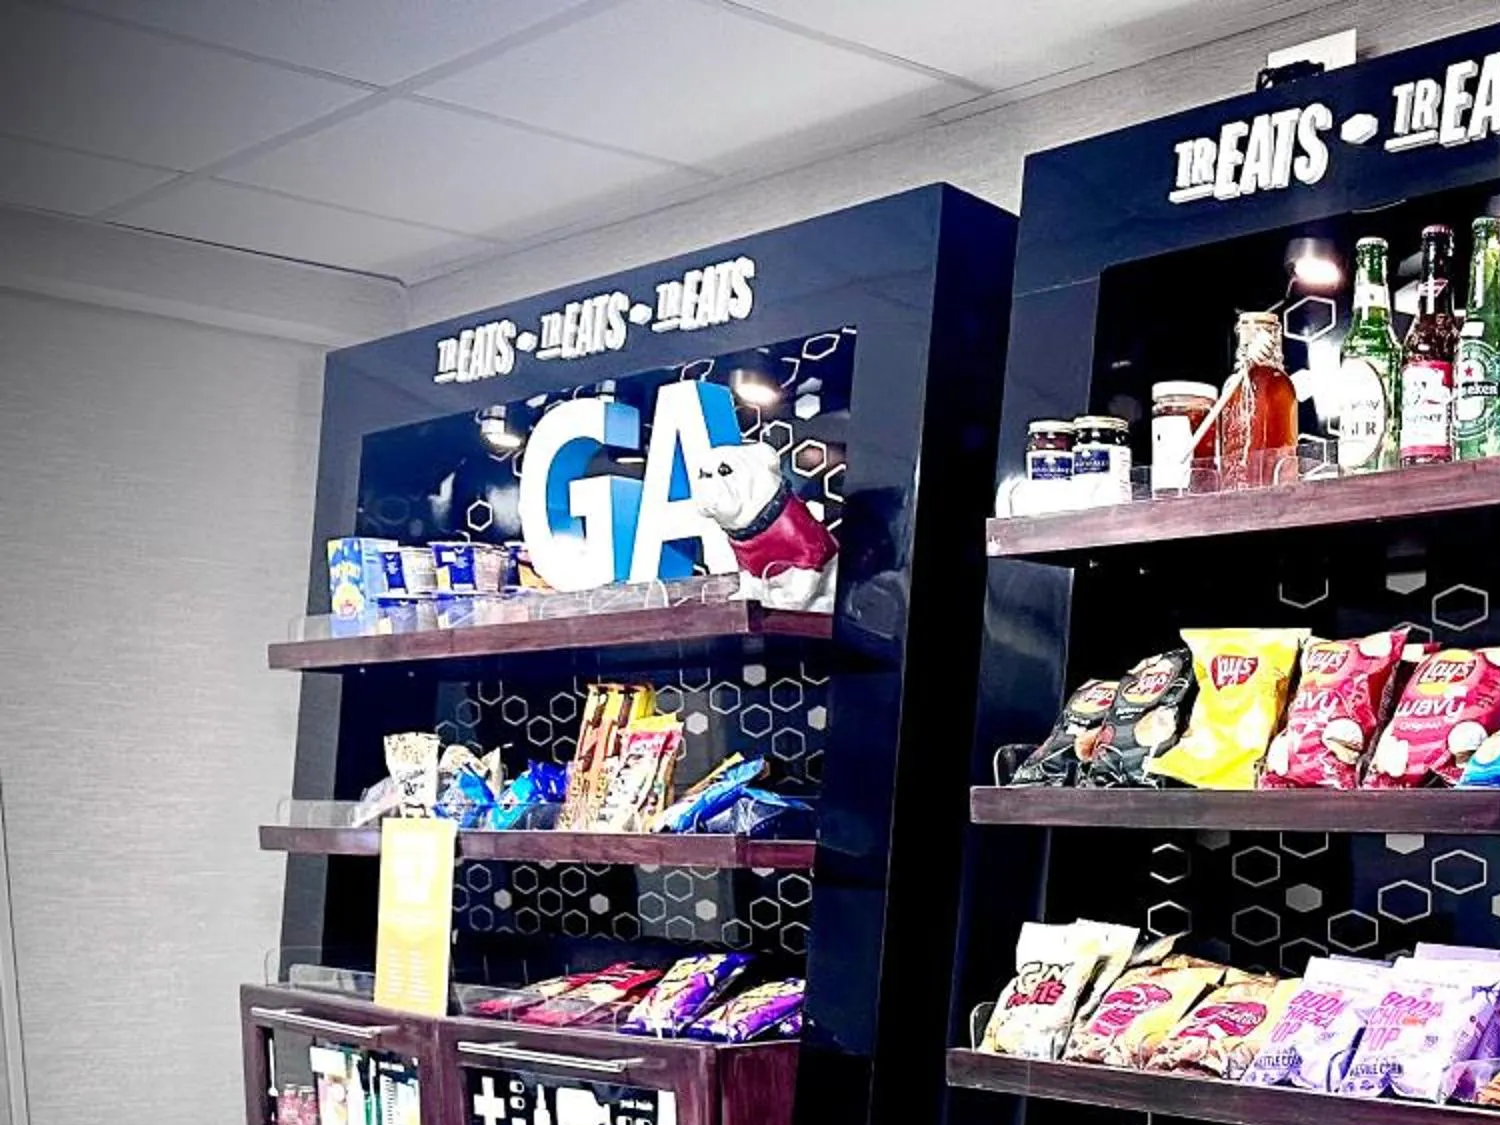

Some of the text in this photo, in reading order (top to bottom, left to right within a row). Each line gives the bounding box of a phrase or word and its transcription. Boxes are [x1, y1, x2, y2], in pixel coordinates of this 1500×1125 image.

[1168, 102, 1332, 203] TREATS
[434, 257, 755, 383] TREATS TREATS TREATS
[519, 380, 743, 593] GA
[1396, 699, 1466, 721] wavy
